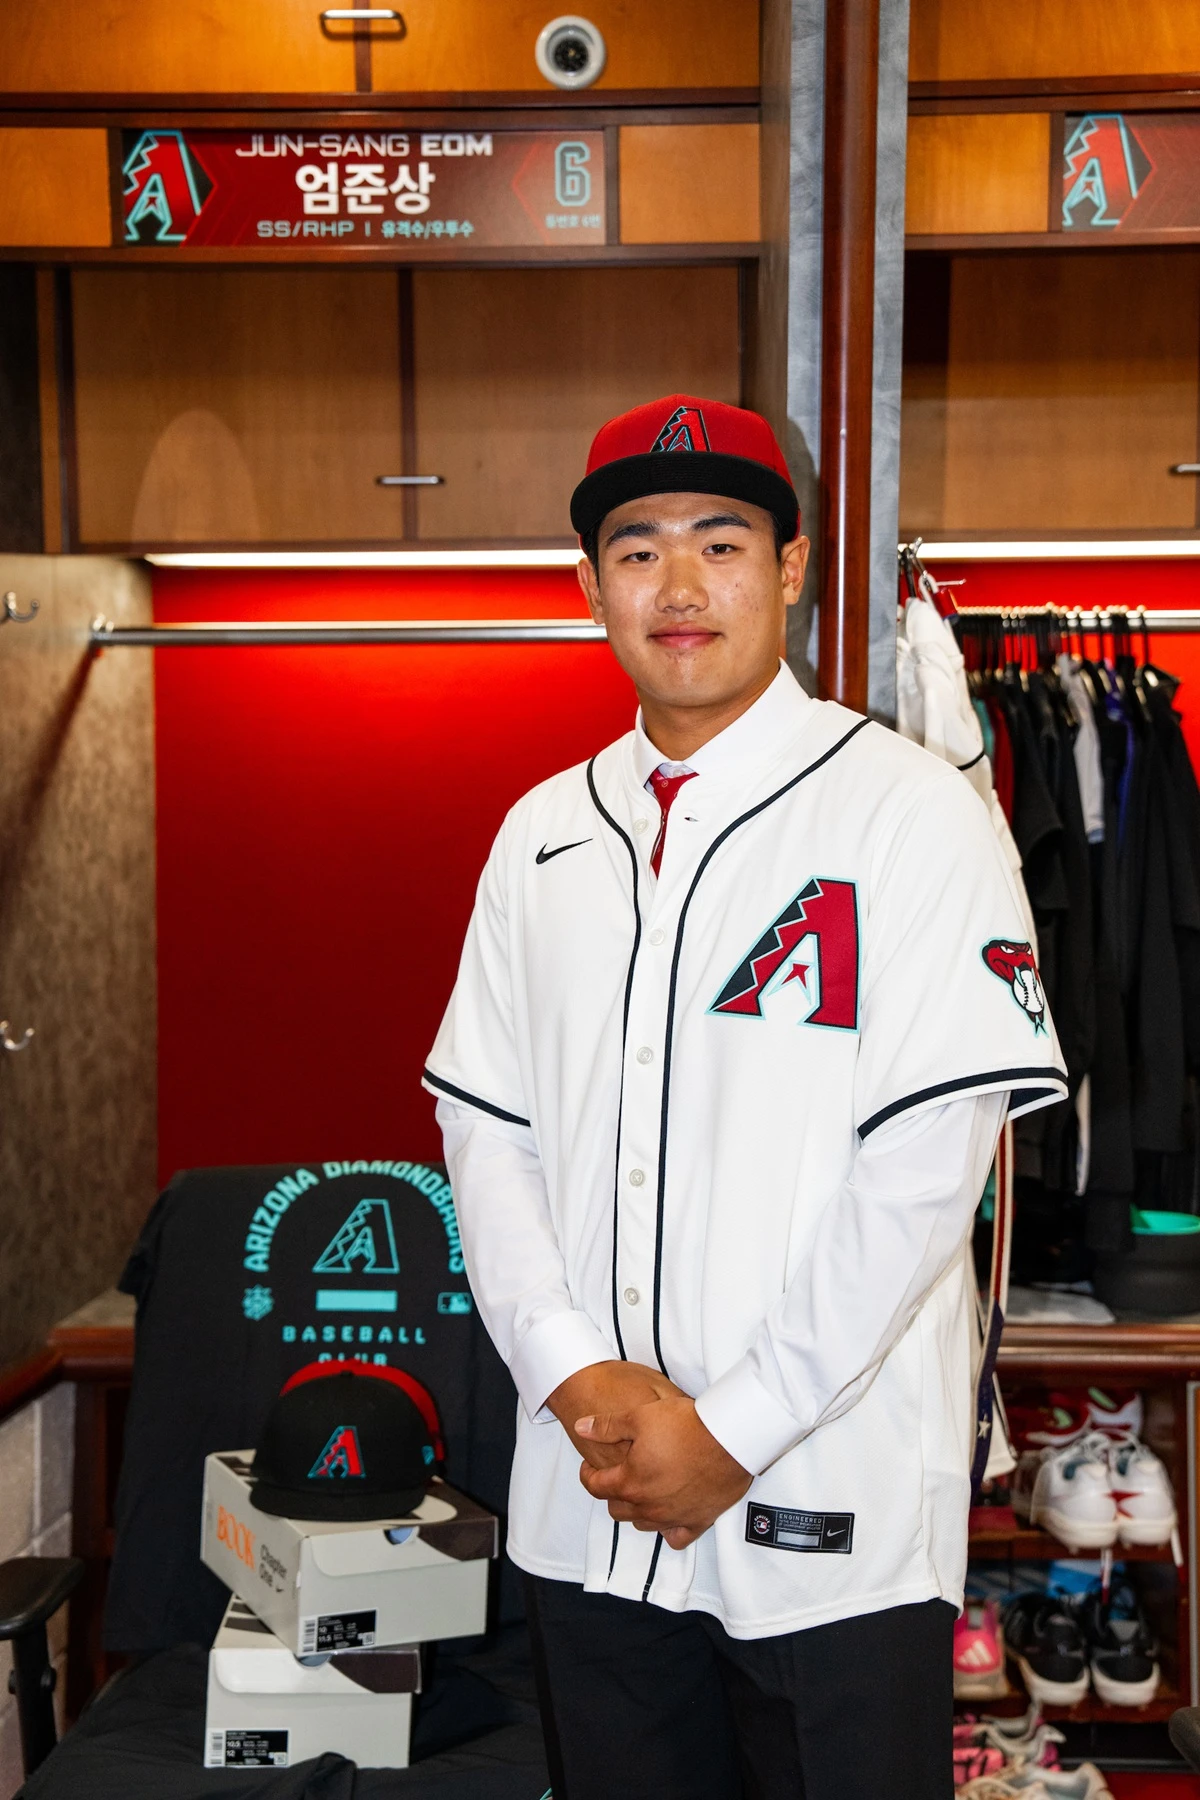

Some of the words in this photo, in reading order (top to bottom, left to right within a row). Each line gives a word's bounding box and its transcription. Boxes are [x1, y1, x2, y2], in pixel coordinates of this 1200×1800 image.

[235, 134, 409, 157] JUN-SANG
[421, 134, 493, 157] EOM
[295, 162, 436, 214] 엄준상
[554, 141, 591, 207] 6
[256, 220, 354, 238] SS/RHP
[243, 1168, 320, 1273] ARIZONA
[282, 1325, 427, 1345] BASEBALL
[778, 1513, 822, 1524] ENGINEERED
[217, 1505, 256, 1573] BOOK
